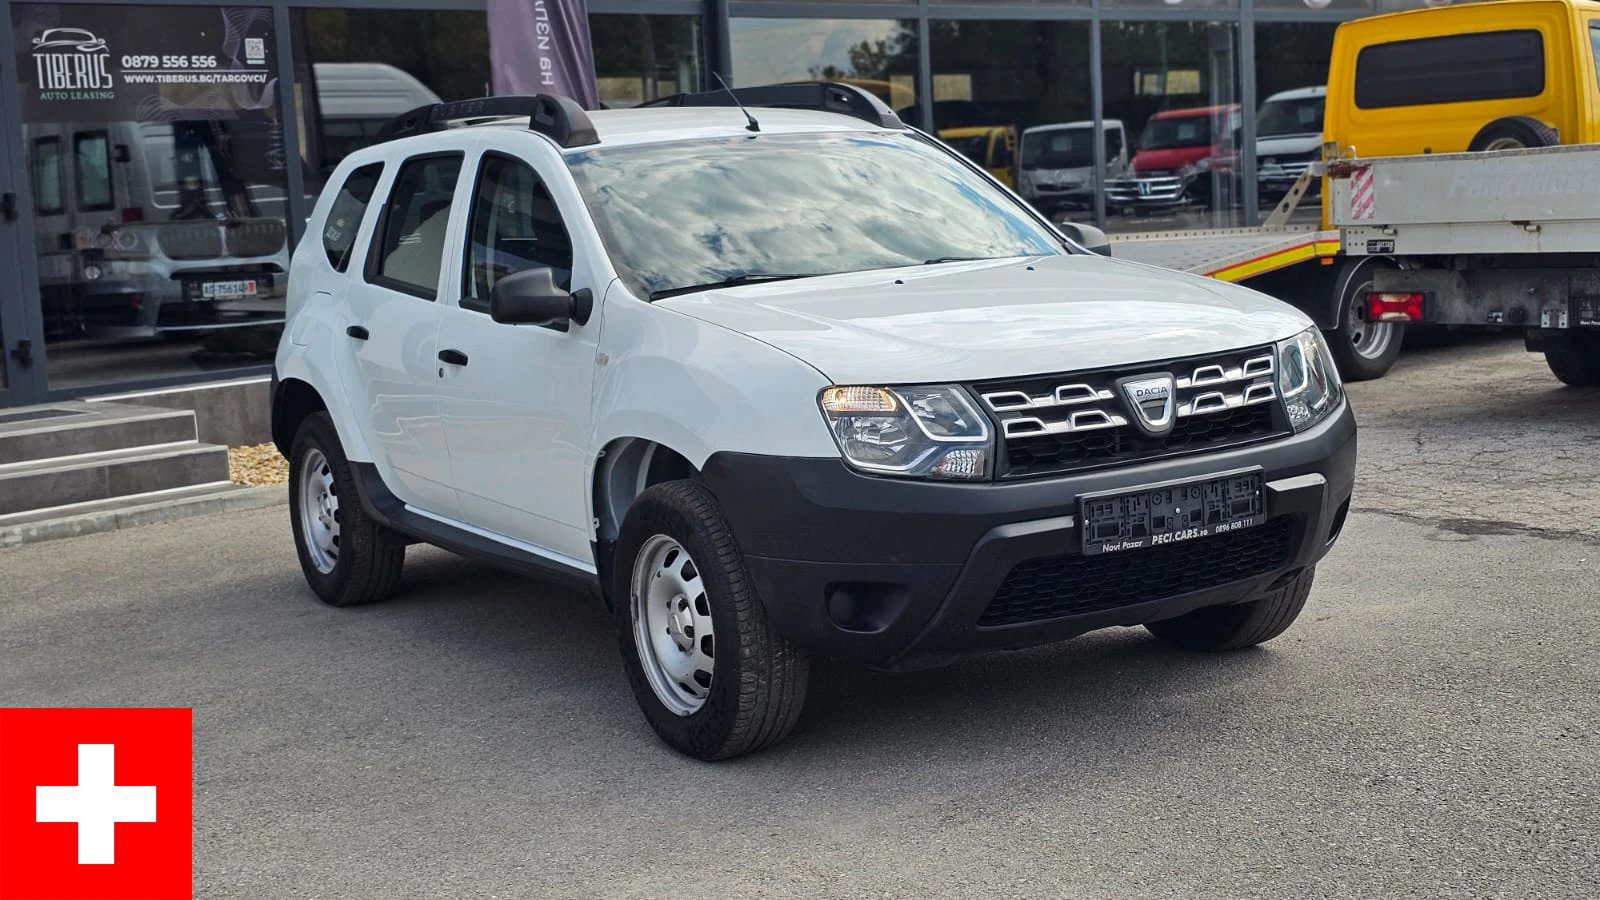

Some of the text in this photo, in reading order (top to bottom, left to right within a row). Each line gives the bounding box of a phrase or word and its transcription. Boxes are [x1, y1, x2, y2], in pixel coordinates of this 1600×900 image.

[121, 55, 217, 68] 0879 556 556
[32, 53, 113, 89] TIBERUS
[123, 73, 267, 84] WWW.TIBERUS.BG/TARGOVCI/
[40, 91, 114, 100] AUTO LEASING
[1136, 386, 1168, 397] DACIA
[1102, 543, 1121, 552] Novi
